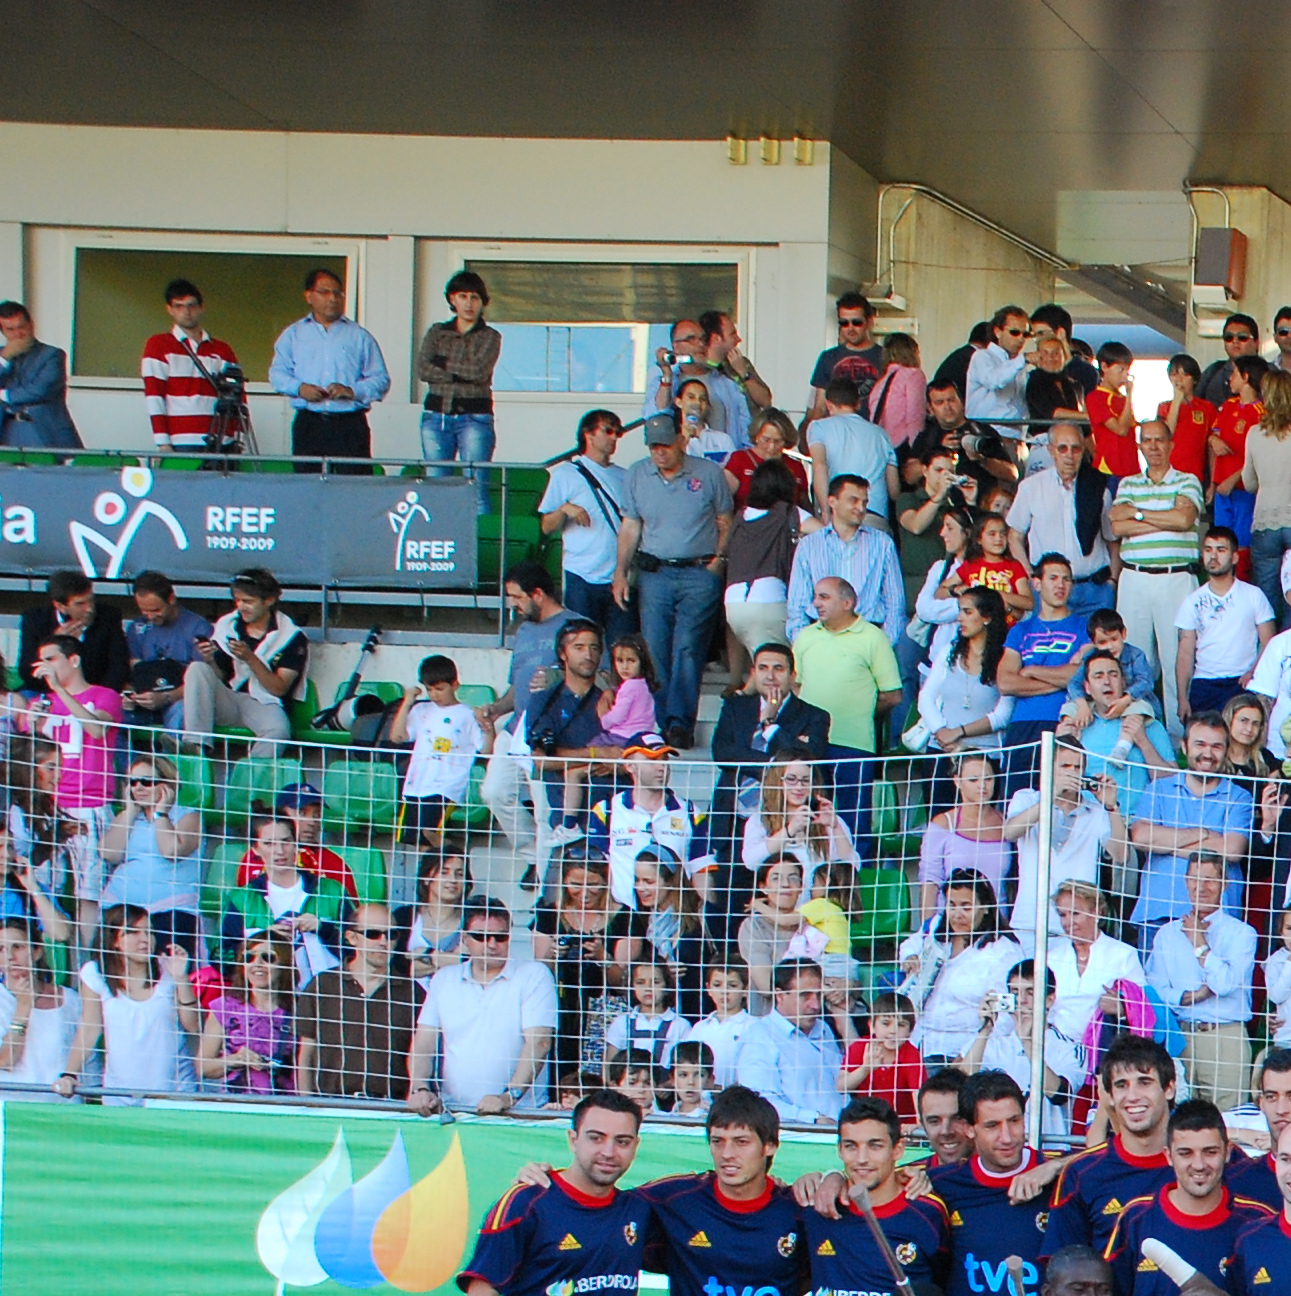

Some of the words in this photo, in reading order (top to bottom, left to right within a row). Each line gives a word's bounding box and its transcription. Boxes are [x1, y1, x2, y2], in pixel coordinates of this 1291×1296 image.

[0, 500, 36, 544] a
[206, 505, 276, 534] RFEF
[206, 535, 275, 551] 1909-2009
[405, 540, 456, 560] RFEF
[406, 561, 455, 572] 1909-2009
